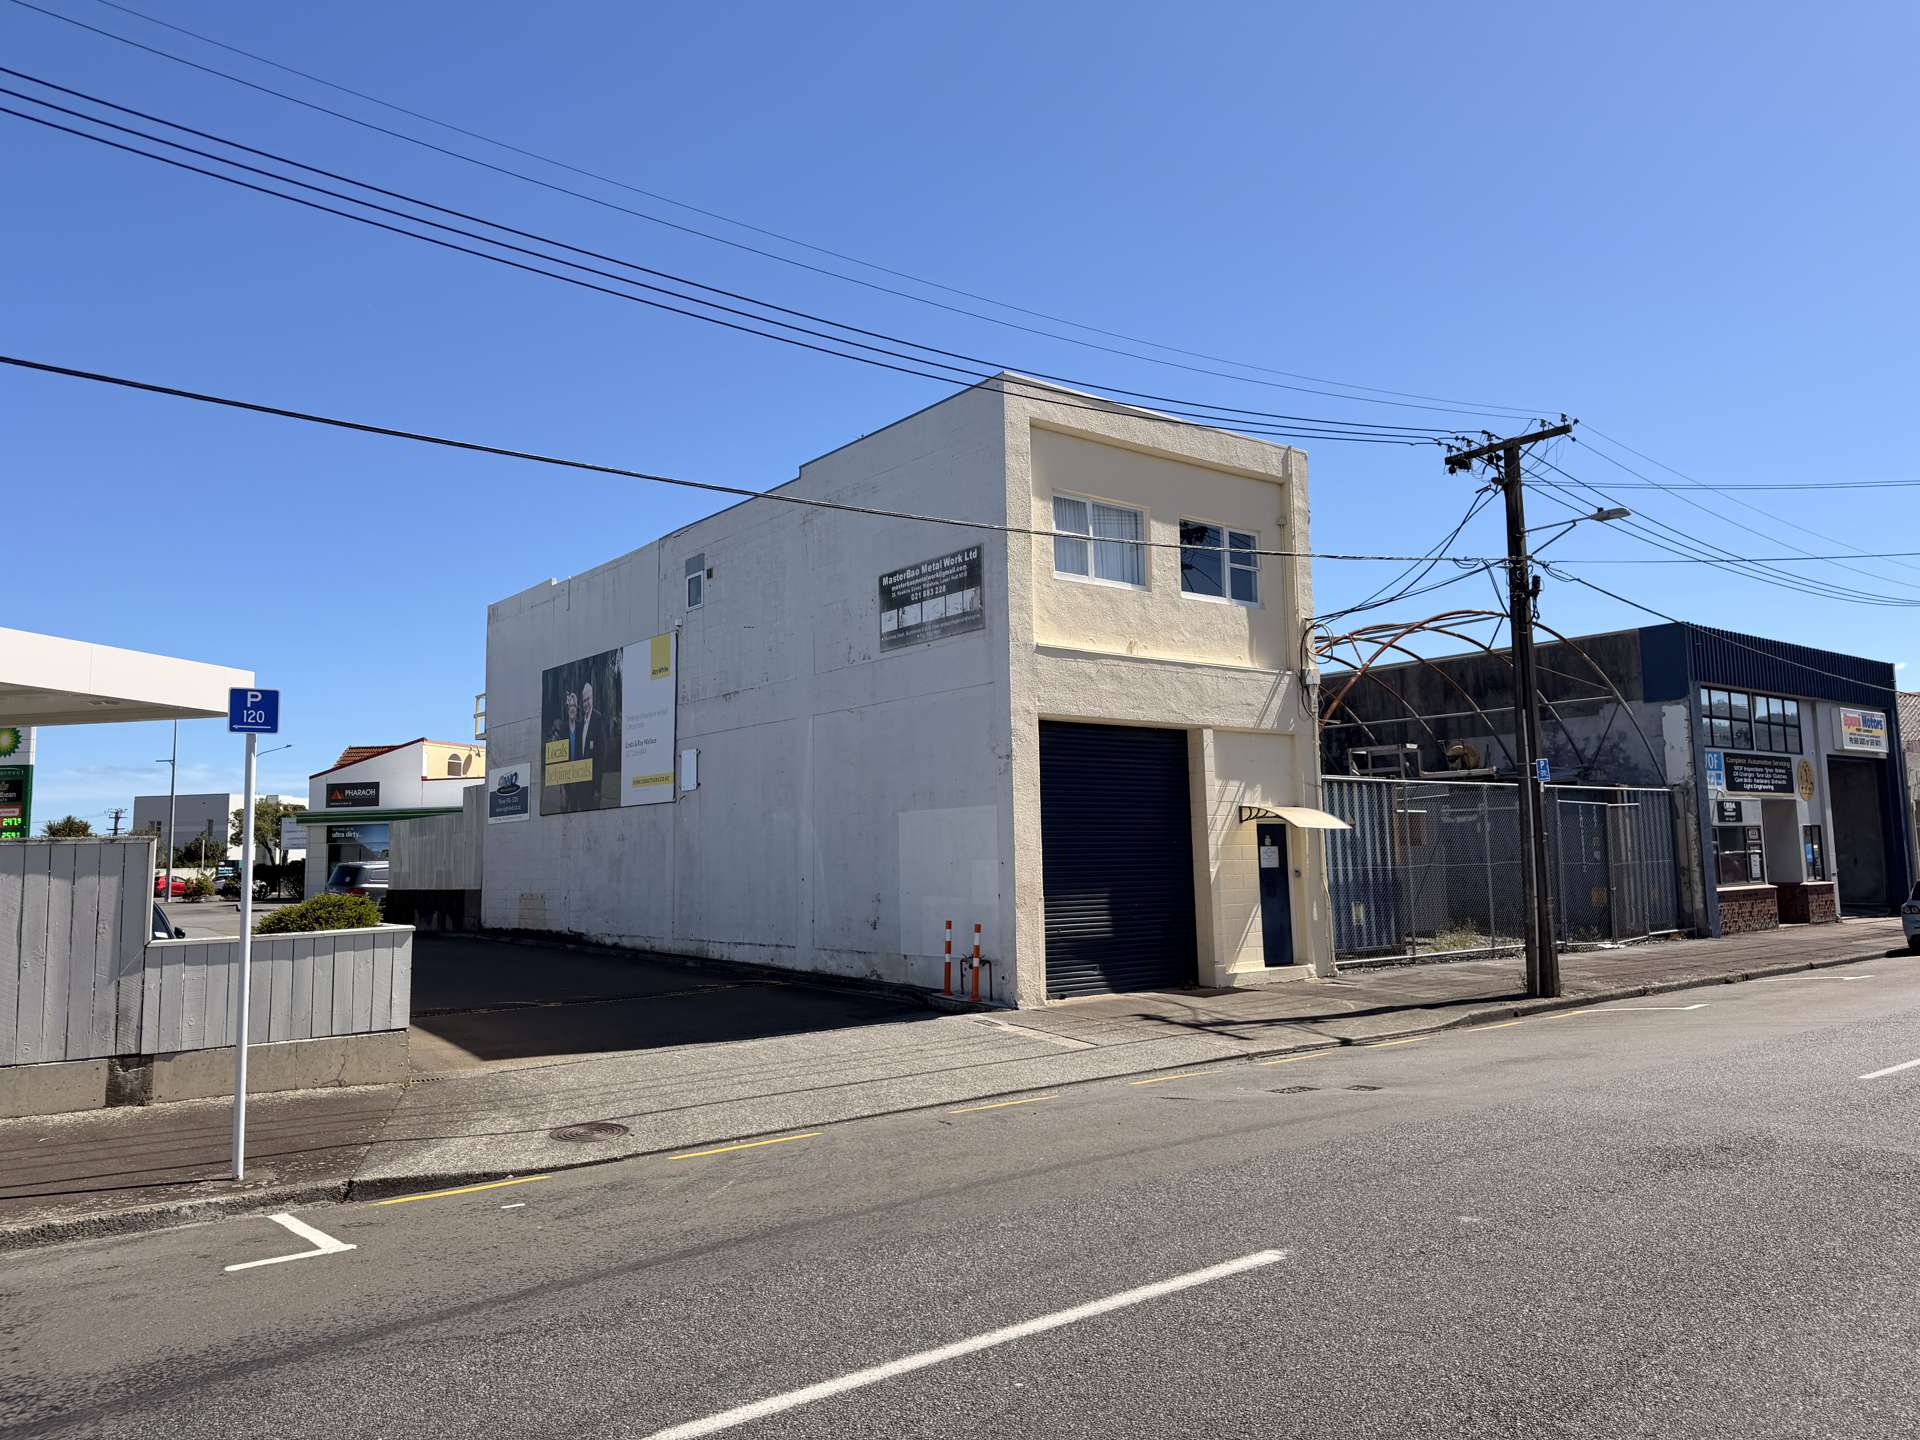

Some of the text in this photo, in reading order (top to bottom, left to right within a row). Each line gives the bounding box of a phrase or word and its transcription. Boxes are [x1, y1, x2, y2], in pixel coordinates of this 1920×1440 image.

[882, 569, 920, 586] MasterBao
[921, 559, 942, 574] Metal
[943, 555, 963, 568] Work
[964, 548, 978, 561] Ltd
[247, 691, 262, 707] P
[243, 710, 265, 723] 120
[1861, 714, 1884, 731] Motors
[345, 788, 376, 796] PHARAOH
